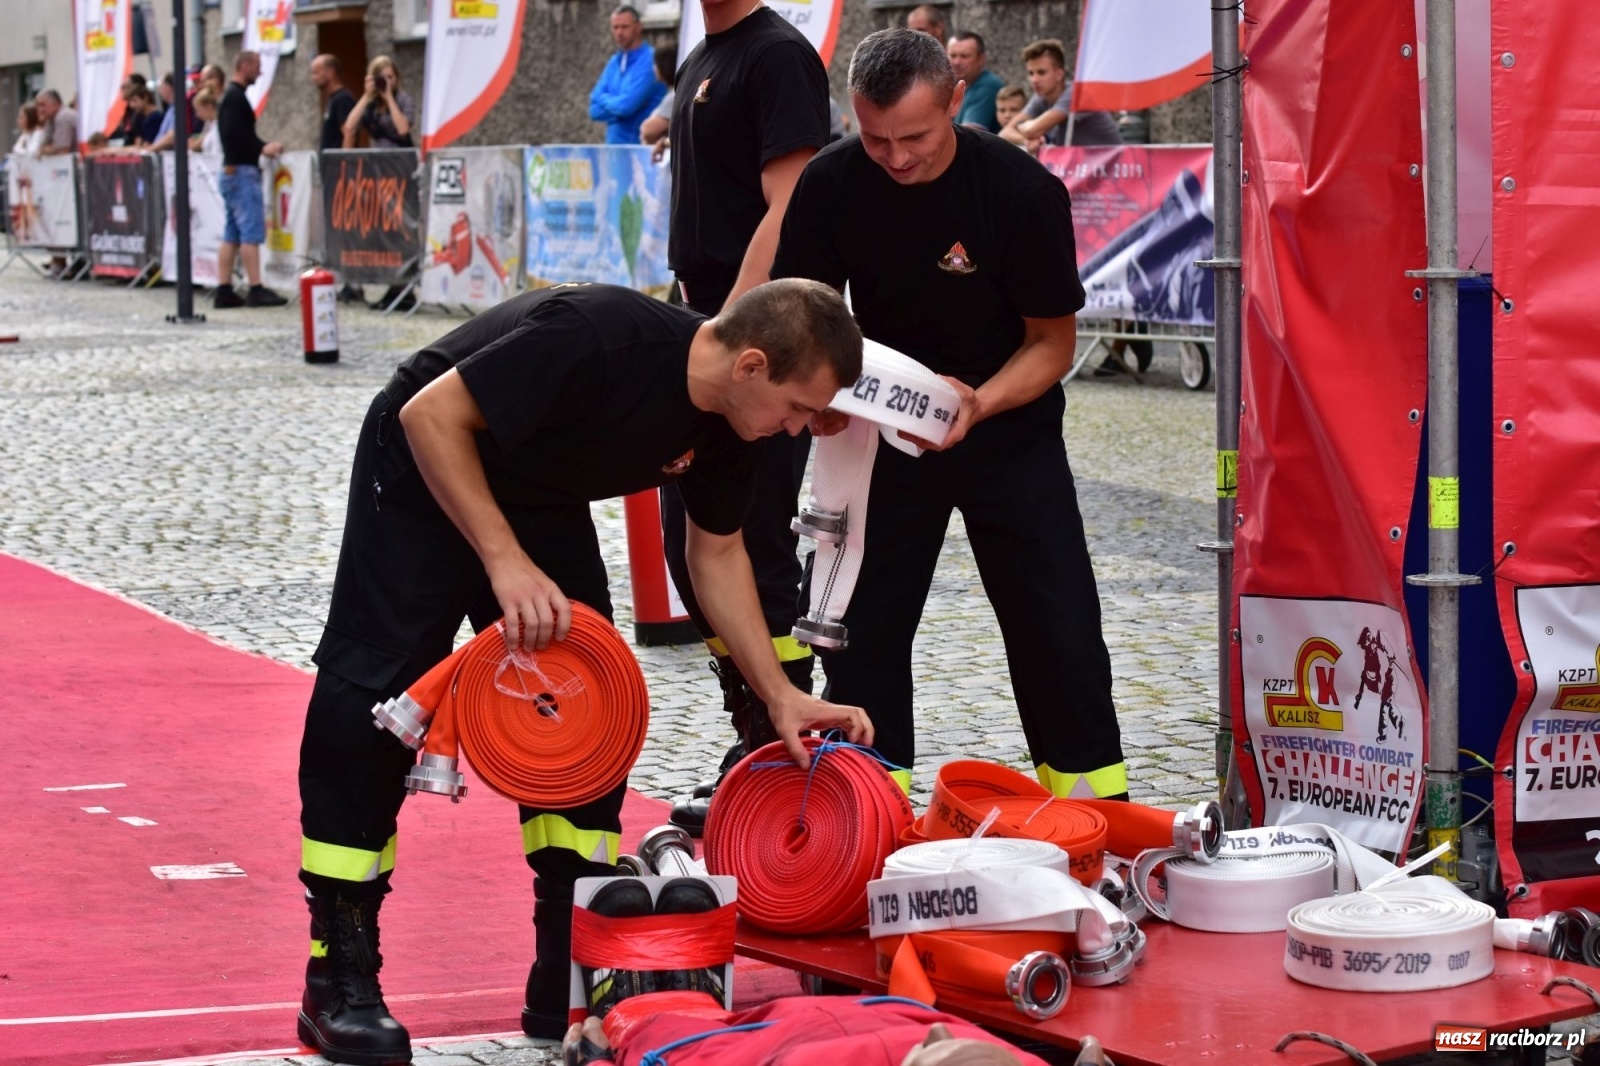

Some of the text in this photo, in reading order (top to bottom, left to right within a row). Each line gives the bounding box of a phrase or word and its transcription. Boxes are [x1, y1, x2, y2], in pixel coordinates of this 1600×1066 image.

[1114, 163, 1144, 179] 2019
[331, 157, 411, 242] dekorex
[885, 384, 930, 419] 2019
[1263, 678, 1295, 692] KZPT
[1558, 668, 1596, 683] KZPT
[1277, 709, 1321, 725] KALISZ
[1564, 697, 1600, 711] KALI
[1531, 719, 1600, 735] FIREFIG
[1261, 734, 1414, 768] FIREFIGHTER COMBAT
[1526, 734, 1600, 764] CHA
[1263, 751, 1415, 797] CHALLENGE
[1525, 765, 1600, 792] 7. EUR
[1267, 777, 1410, 824] 7. EUROPEAN FCC
[878, 892, 899, 924] GIL
[908, 885, 978, 921] BOGDAN
[1447, 951, 1471, 971] 0107
